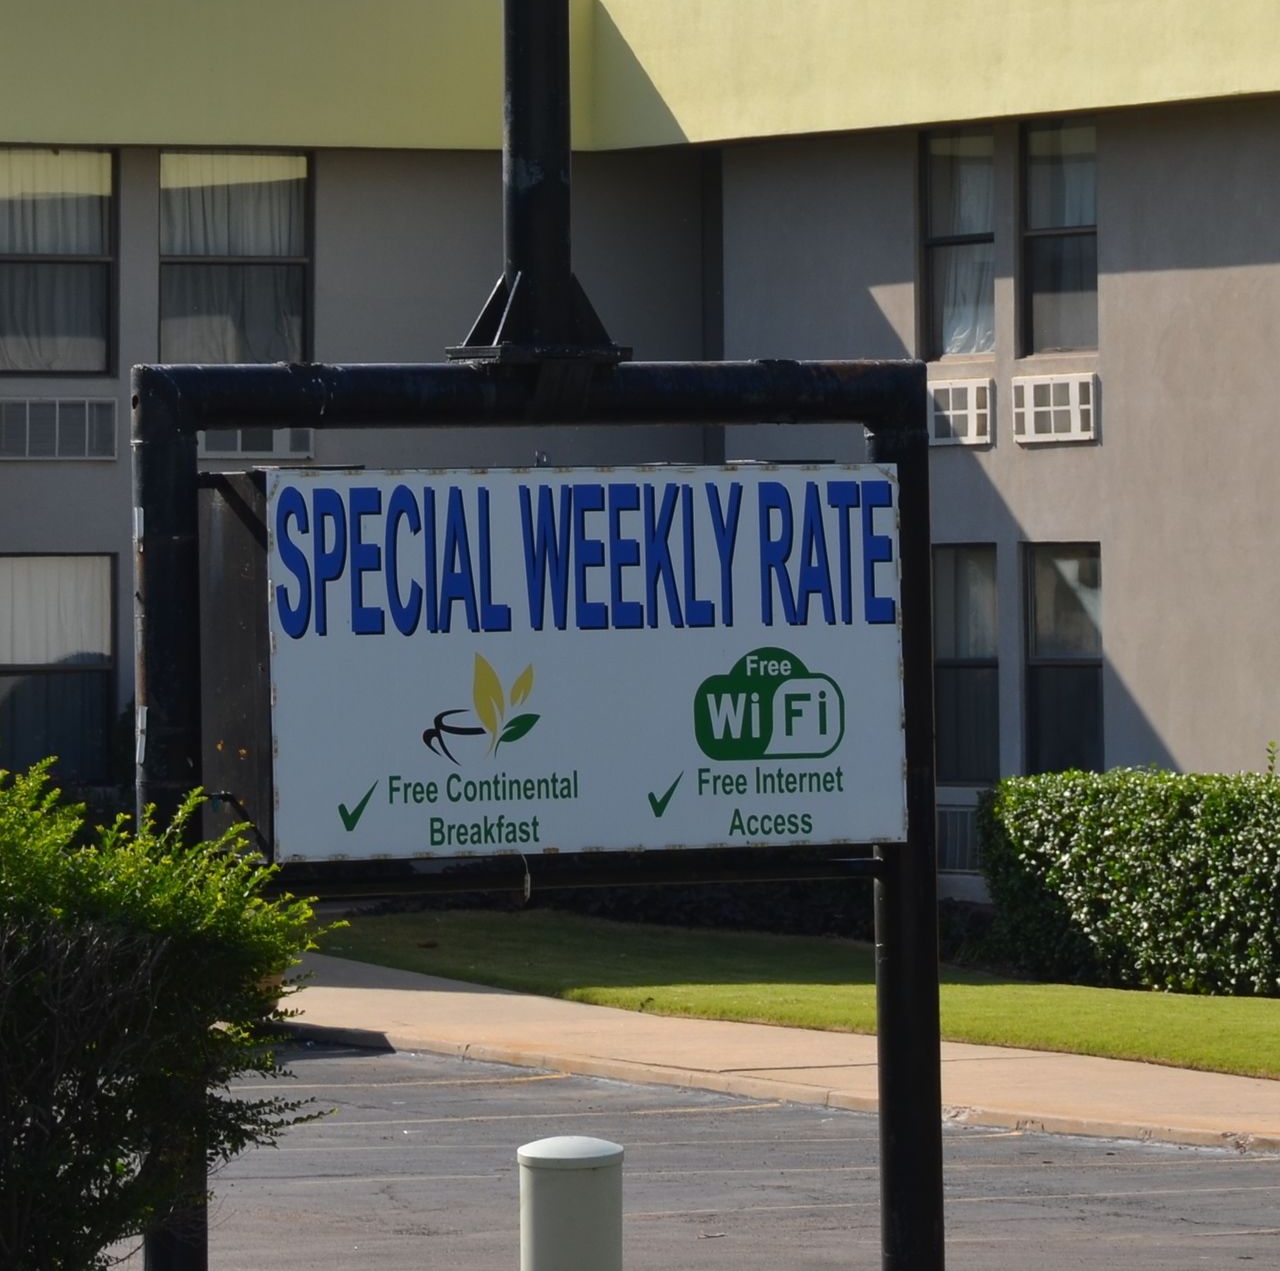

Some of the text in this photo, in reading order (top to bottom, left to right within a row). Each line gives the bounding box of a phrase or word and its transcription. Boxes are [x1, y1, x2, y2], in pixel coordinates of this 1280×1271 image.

[276, 481, 897, 639] SPECIAL WEEKLY RATE
[745, 655, 793, 677] Free
[388, 770, 579, 805] Free Continental
[697, 765, 844, 796] Free Internet
[429, 814, 540, 846] Breakfast
[728, 808, 813, 836] Access
